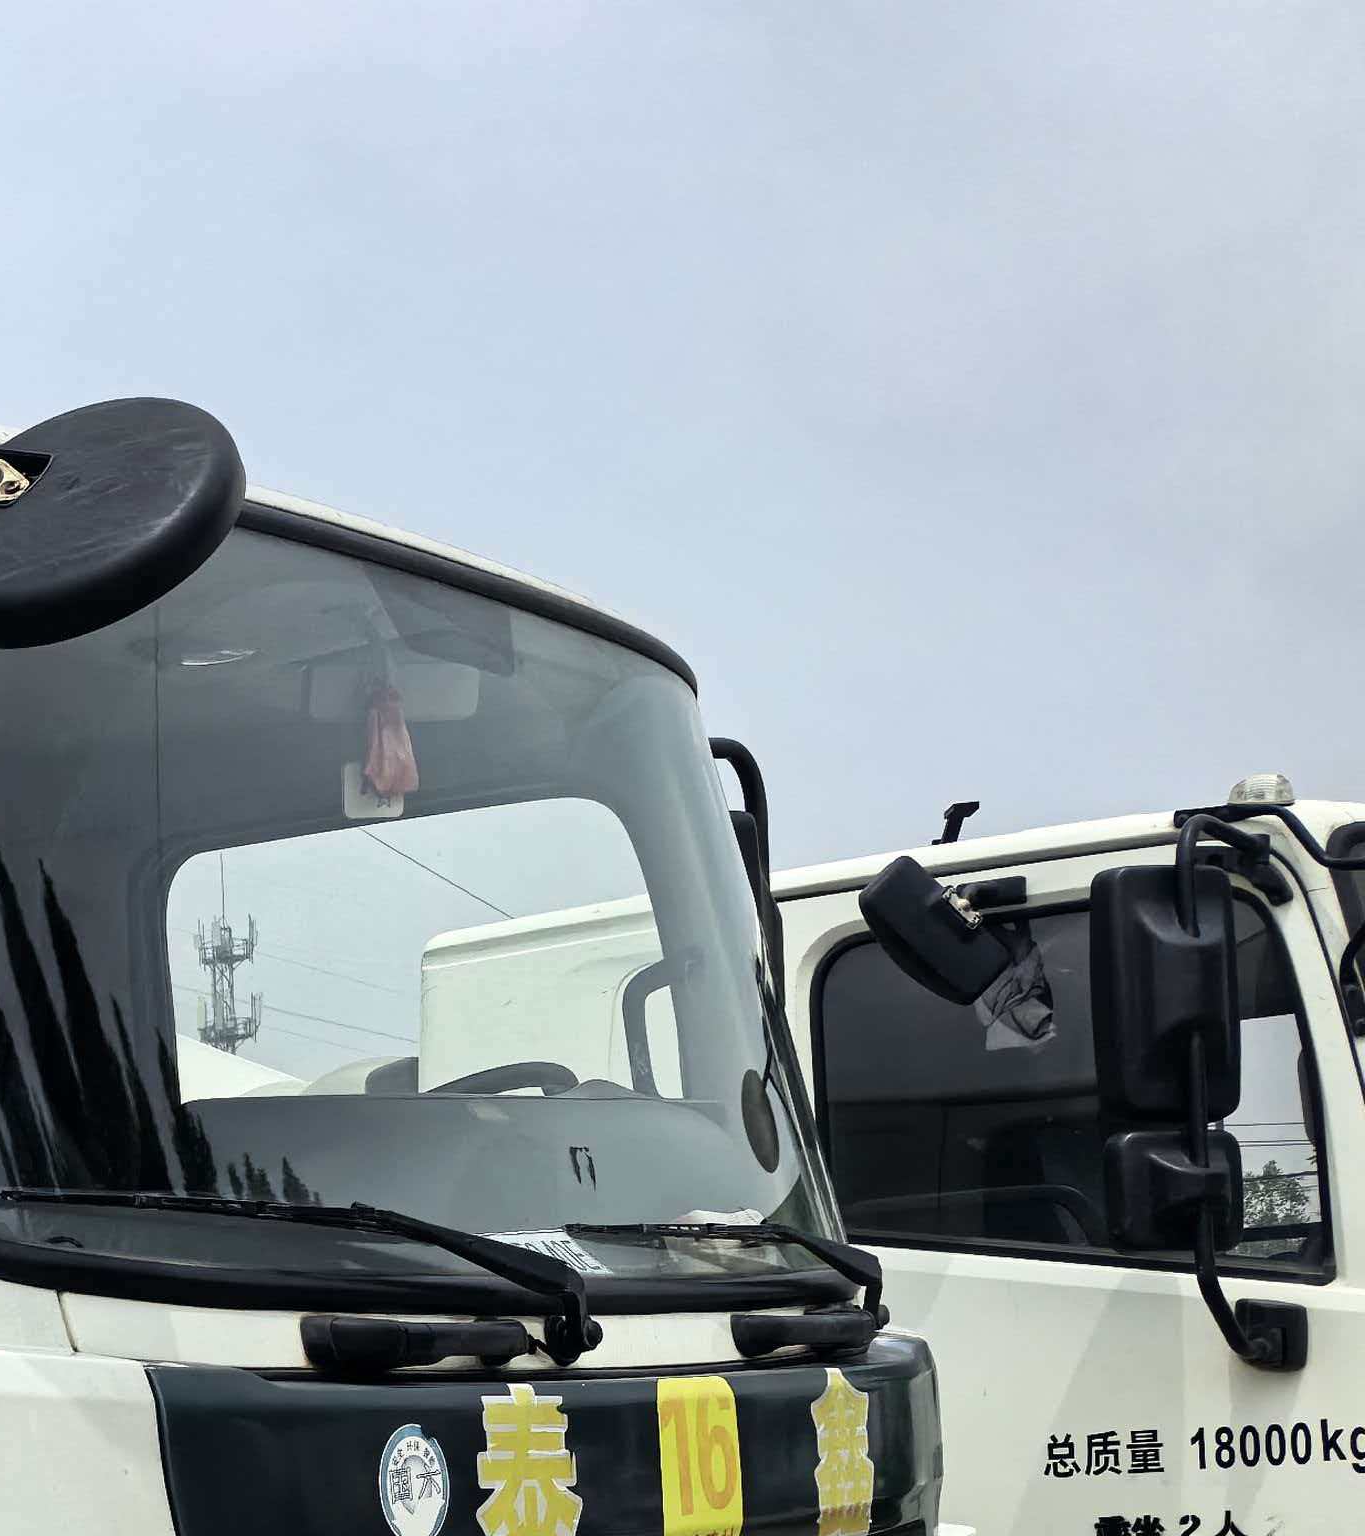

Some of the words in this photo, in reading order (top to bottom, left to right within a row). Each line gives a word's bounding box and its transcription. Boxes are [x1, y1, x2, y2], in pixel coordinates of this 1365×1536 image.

[660, 1392, 738, 1516] 16
[1043, 1430, 1165, 1478] 总质量
